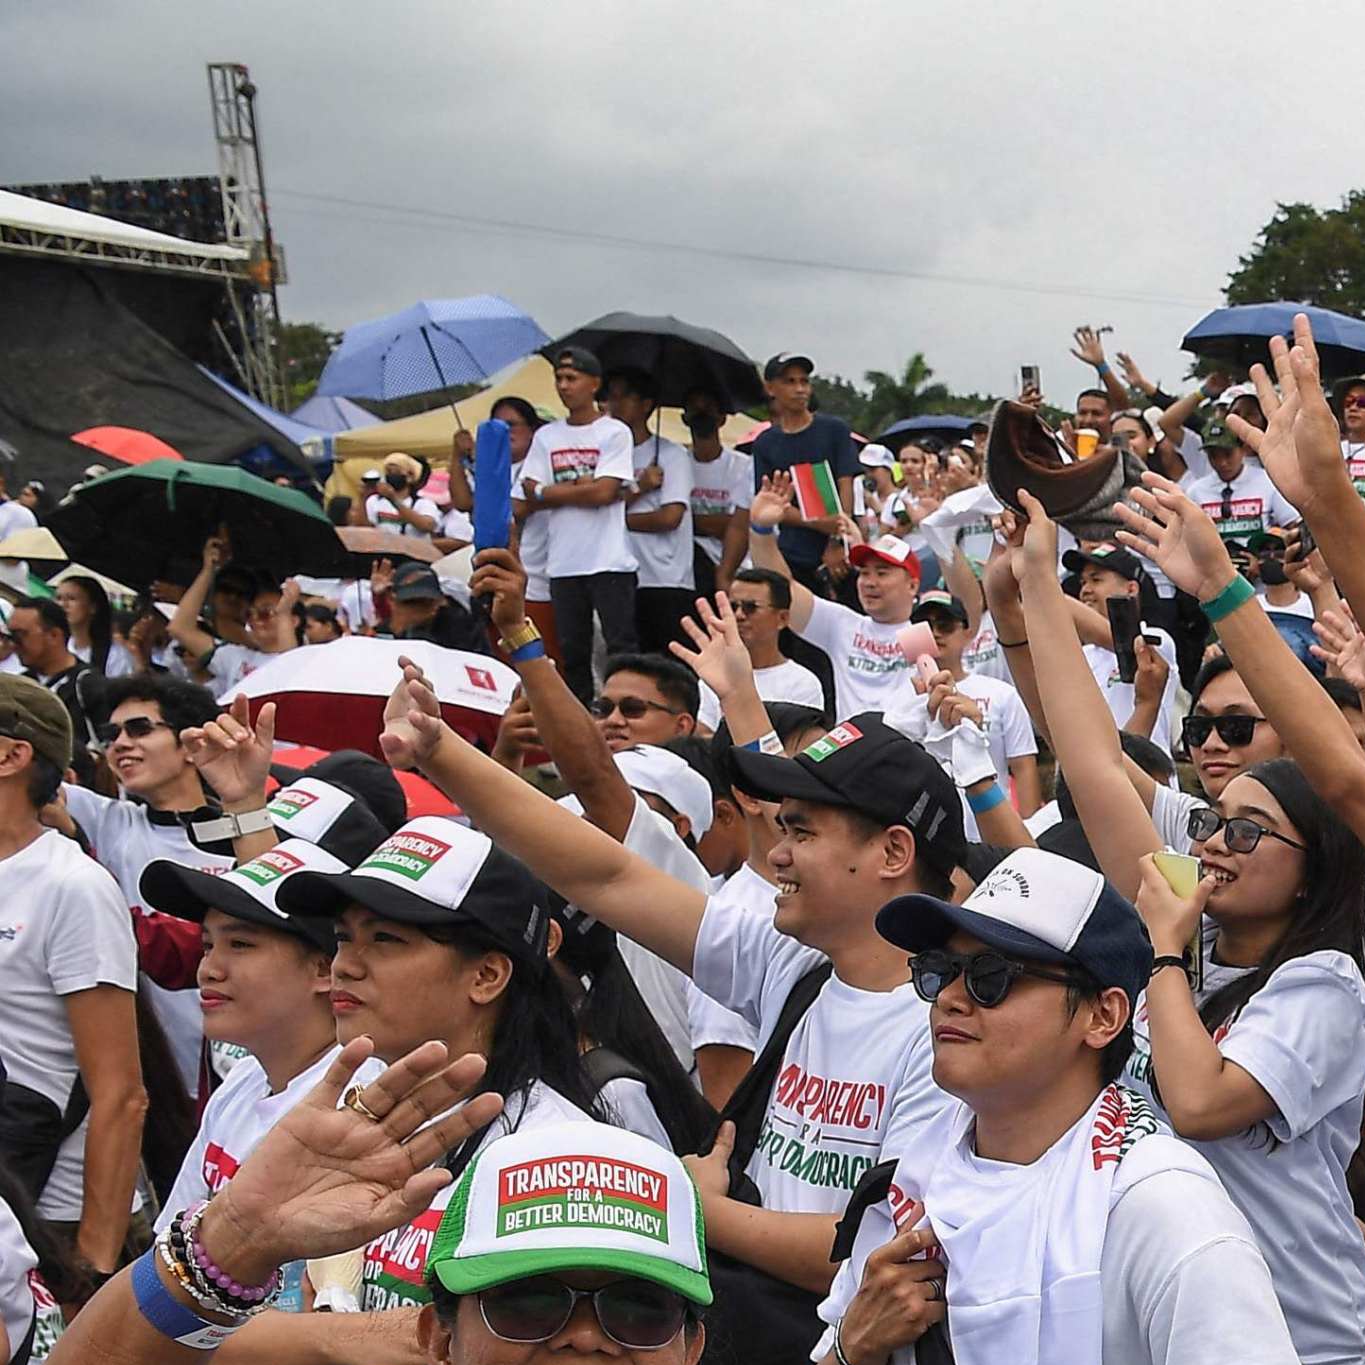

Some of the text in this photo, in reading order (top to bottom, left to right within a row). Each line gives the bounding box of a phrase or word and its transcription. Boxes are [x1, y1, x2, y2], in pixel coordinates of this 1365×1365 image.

[506, 1160, 662, 1202] TRANSPARENCY
[566, 1188, 603, 1203] FOR A
[504, 1202, 662, 1237] BETTER DEMOCRACY
[364, 1260, 384, 1280] OR
